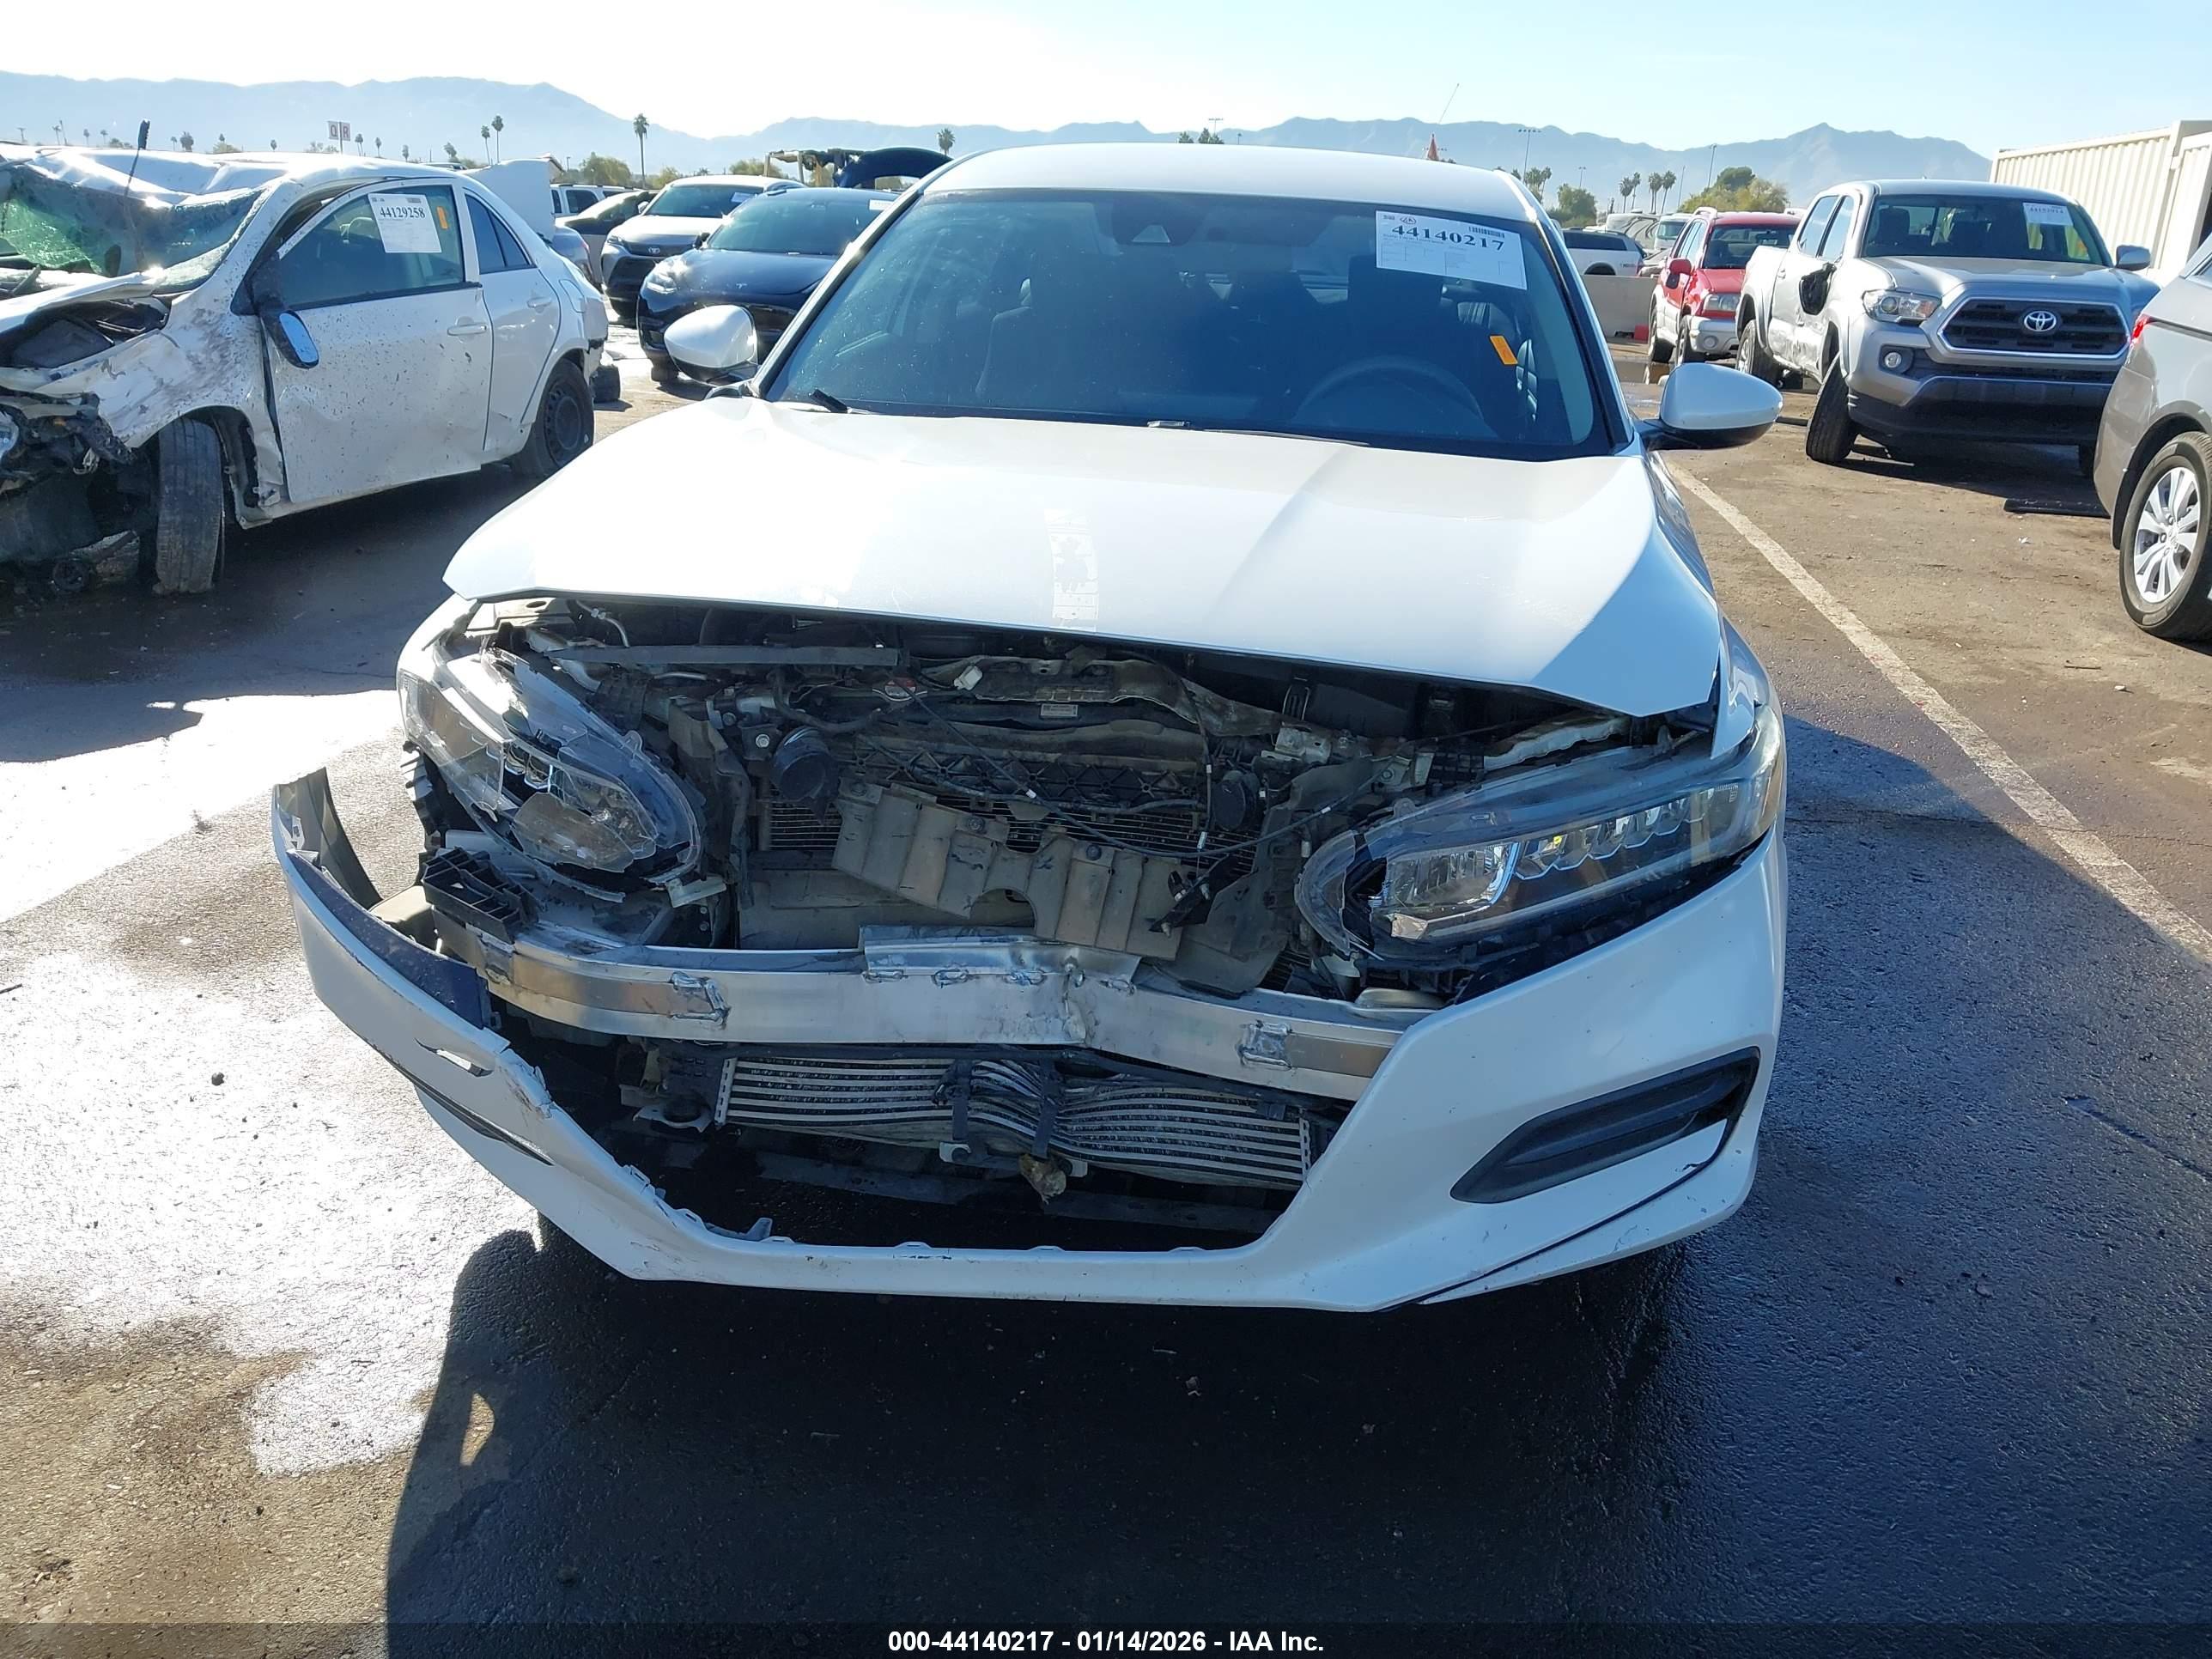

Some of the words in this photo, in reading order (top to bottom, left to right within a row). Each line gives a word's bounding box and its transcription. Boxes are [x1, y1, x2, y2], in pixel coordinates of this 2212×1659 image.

[343, 125, 349, 138] R
[380, 207, 426, 219] 44129258
[1392, 225, 1504, 251] 44140217
